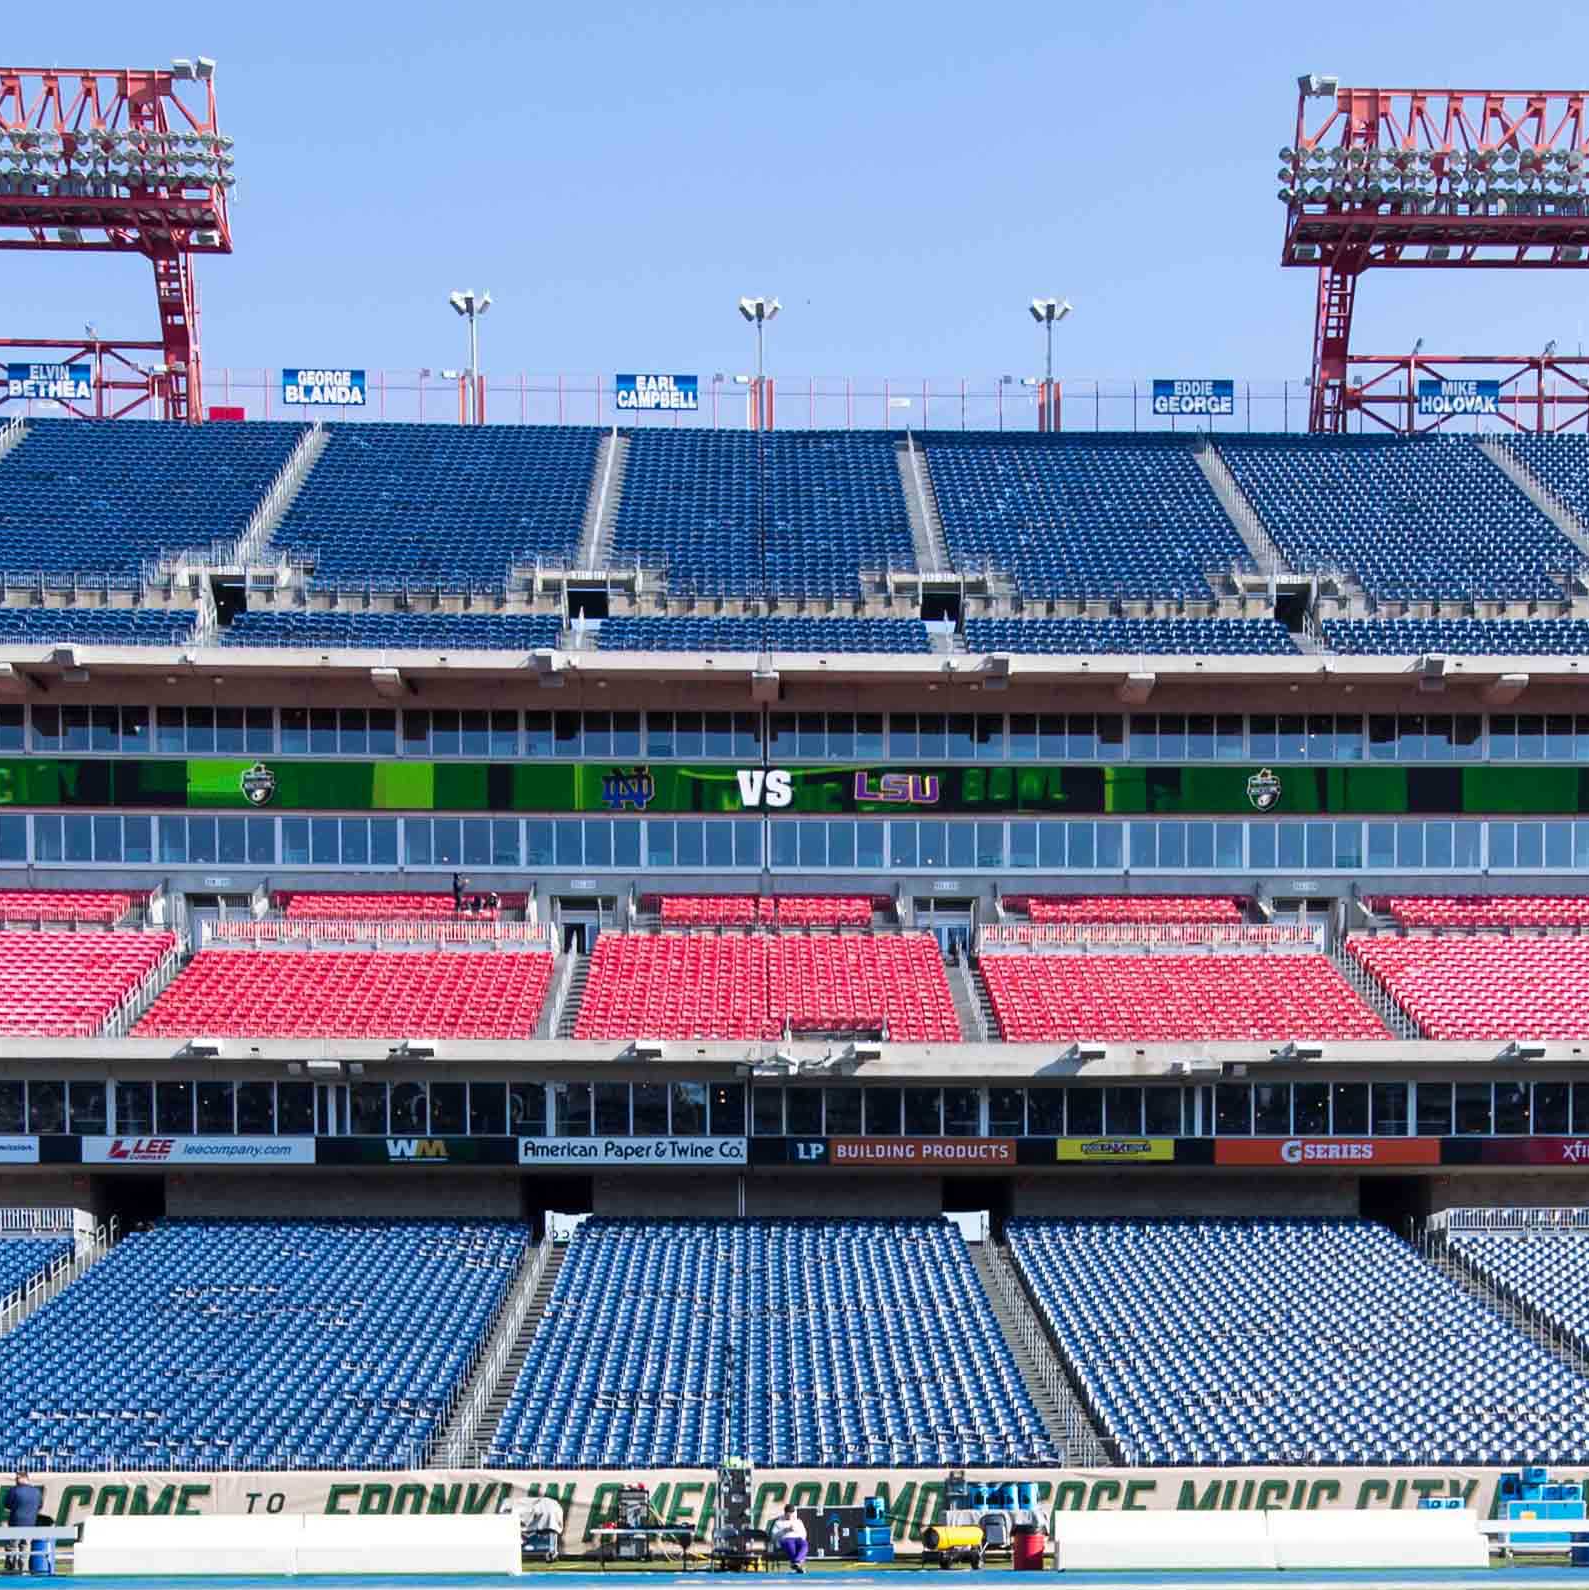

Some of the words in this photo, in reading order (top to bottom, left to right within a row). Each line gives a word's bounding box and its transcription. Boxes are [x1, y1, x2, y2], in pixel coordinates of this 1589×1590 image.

[29, 364, 70, 380] ELVIN
[298, 371, 352, 385] GEORGE
[10, 380, 90, 399] BETHEA
[636, 376, 677, 391] EARL
[1173, 381, 1213, 396] EDDIE
[1440, 381, 1477, 396] MIKE
[285, 386, 364, 404] BLANDA
[617, 391, 697, 409] CAMPBELL
[1154, 395, 1233, 414] GEORGE
[1420, 395, 1498, 414] HOLOVAK
[736, 769, 794, 808] VS
[853, 771, 939, 805] LSU
[134, 1139, 175, 1154] LEE
[182, 1142, 292, 1157] leecompany.com
[523, 1140, 598, 1158] American
[604, 1141, 650, 1160] Paper
[653, 1141, 667, 1158] &
[667, 1141, 715, 1158] Twine
[797, 1143, 824, 1160] LP
[836, 1143, 915, 1159] BUILDING
[921, 1143, 1010, 1159] PRODUCTS
[1303, 1143, 1374, 1160] SERIES
[245, 1493, 285, 1514] TO
